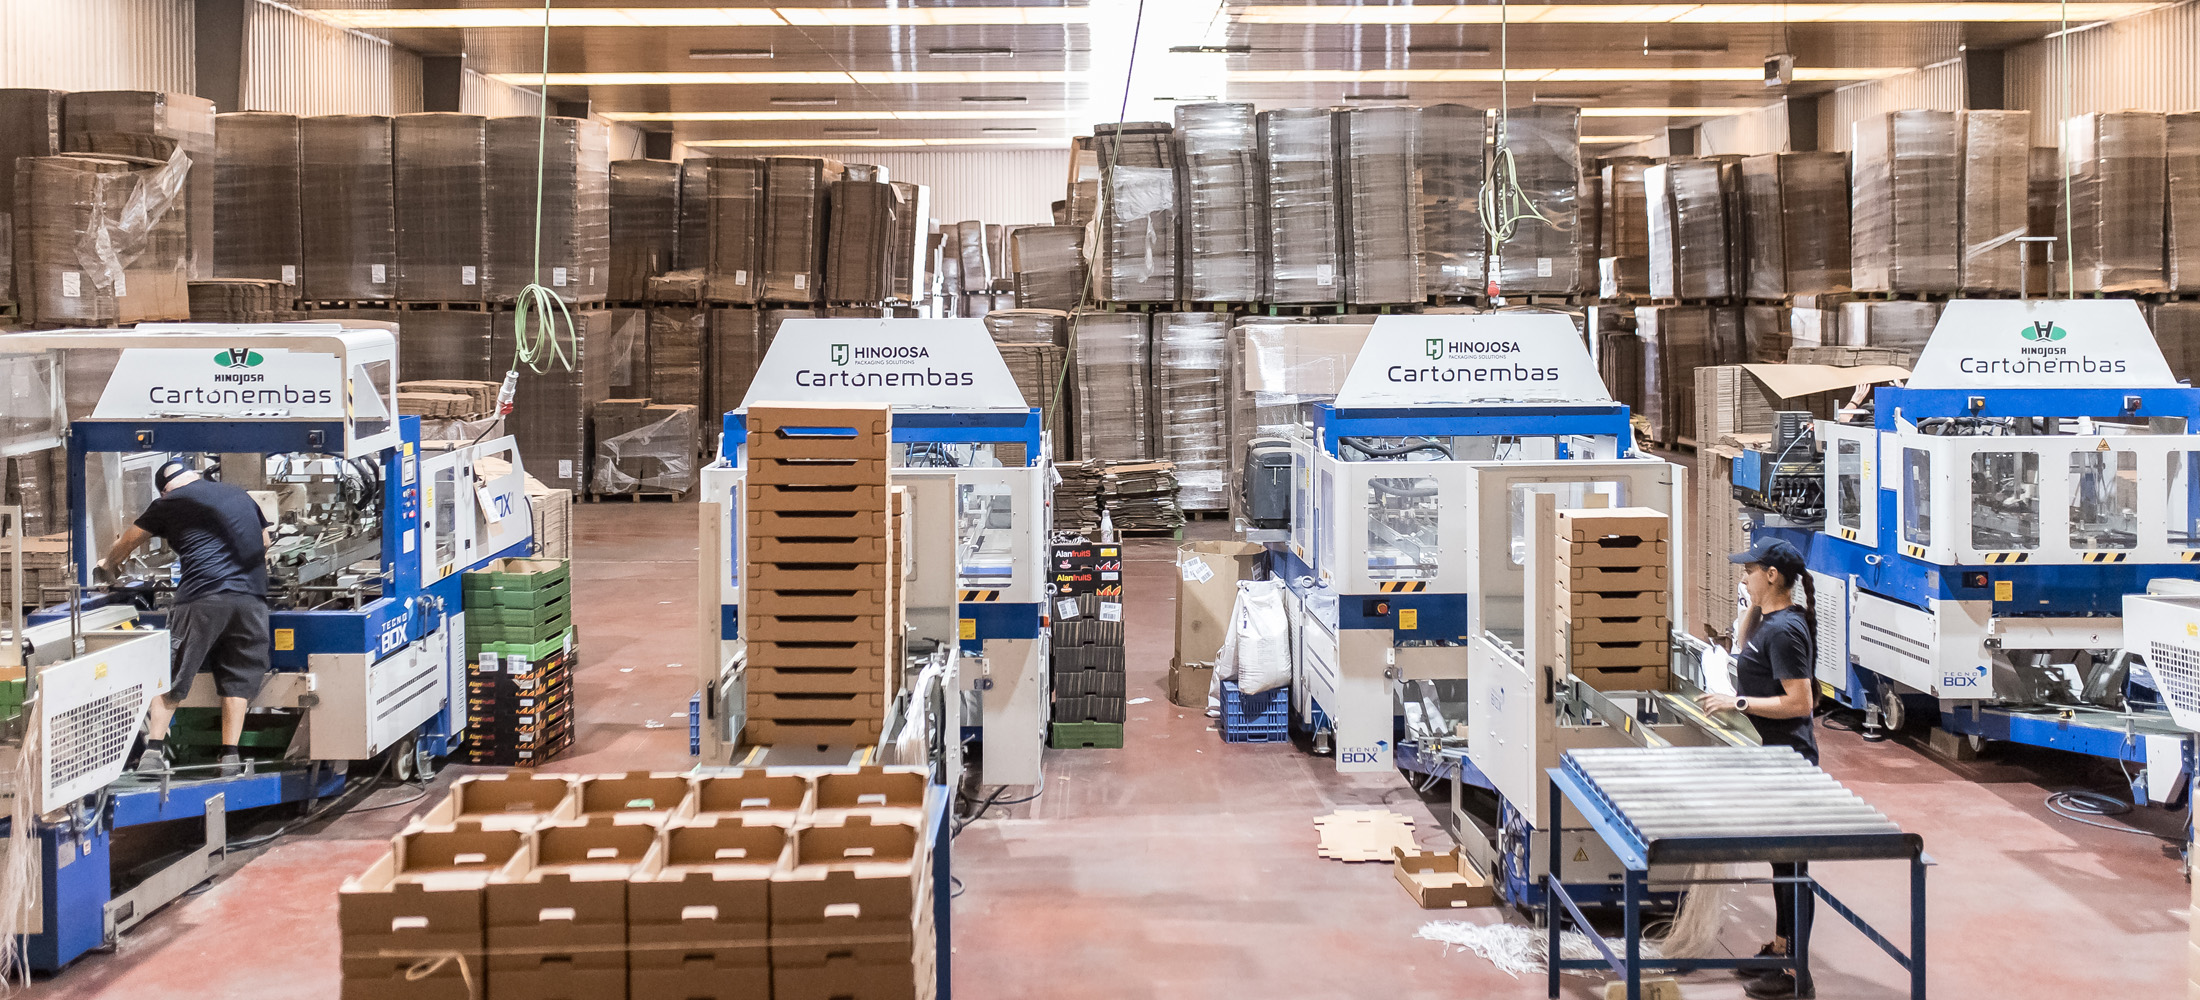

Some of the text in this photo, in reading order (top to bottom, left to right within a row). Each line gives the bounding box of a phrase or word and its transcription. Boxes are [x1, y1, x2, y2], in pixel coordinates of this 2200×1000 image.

[855, 346, 929, 359] HINOJOSA
[1449, 342, 1520, 353] HINOJOSA
[2021, 347, 2067, 357] HINOJOSA
[214, 373, 264, 385] HINOJOSA
[381, 612, 408, 632] TECNO
[381, 622, 408, 655] BOX
[1943, 676, 1978, 687] BOX
[1342, 752, 1378, 763] BOX
